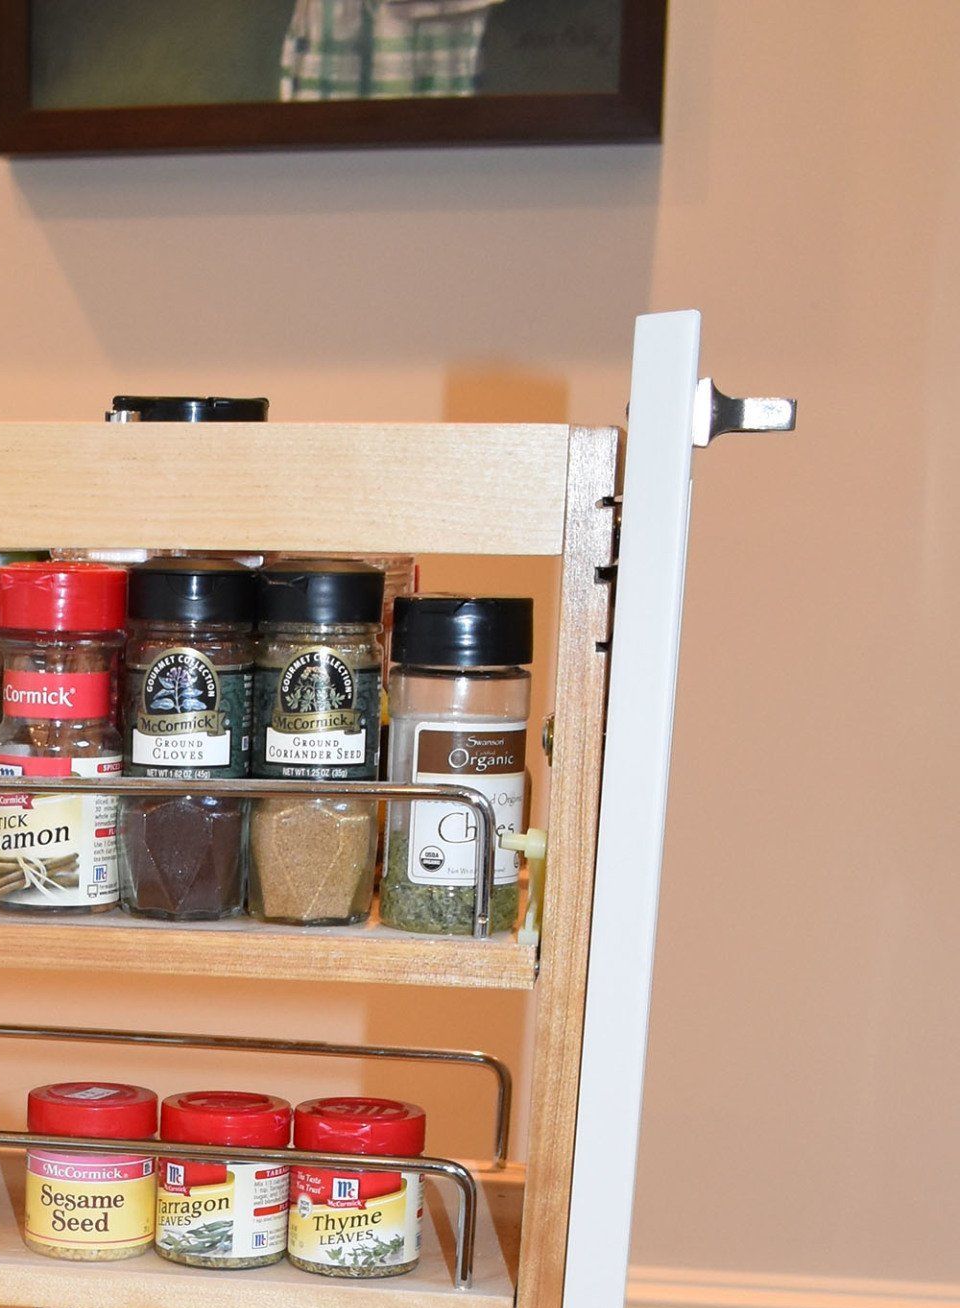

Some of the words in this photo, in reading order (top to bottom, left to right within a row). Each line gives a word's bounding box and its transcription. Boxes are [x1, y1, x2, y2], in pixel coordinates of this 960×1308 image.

[147, 655, 175, 693] GOURMET
[178, 655, 215, 697] COLLECTION
[282, 655, 311, 693] GOURMET
[313, 654, 353, 694] CLLECTION
[3, 684, 74, 708] Cormick
[140, 715, 213, 733] McCormick
[274, 714, 348, 731] McCormick
[155, 738, 203, 748] GROUND
[292, 737, 340, 748] GROUND
[465, 735, 505, 748] Swanson
[152, 748, 204, 760] CLOVES
[269, 745, 332, 760] CORIANDER
[336, 747, 362, 760] SEED
[448, 748, 514, 772] Organic
[282, 767, 294, 776] NET
[43, 1163, 123, 1179] McCormick
[40, 1183, 125, 1211] Sesame
[328, 1199, 363, 1208] McCormick
[158, 1197, 230, 1219] Tarragon
[51, 1209, 110, 1233] Seed
[158, 1215, 192, 1227] LEAVES
[313, 1210, 382, 1235] Thyme
[320, 1229, 374, 1246] LEAVES
